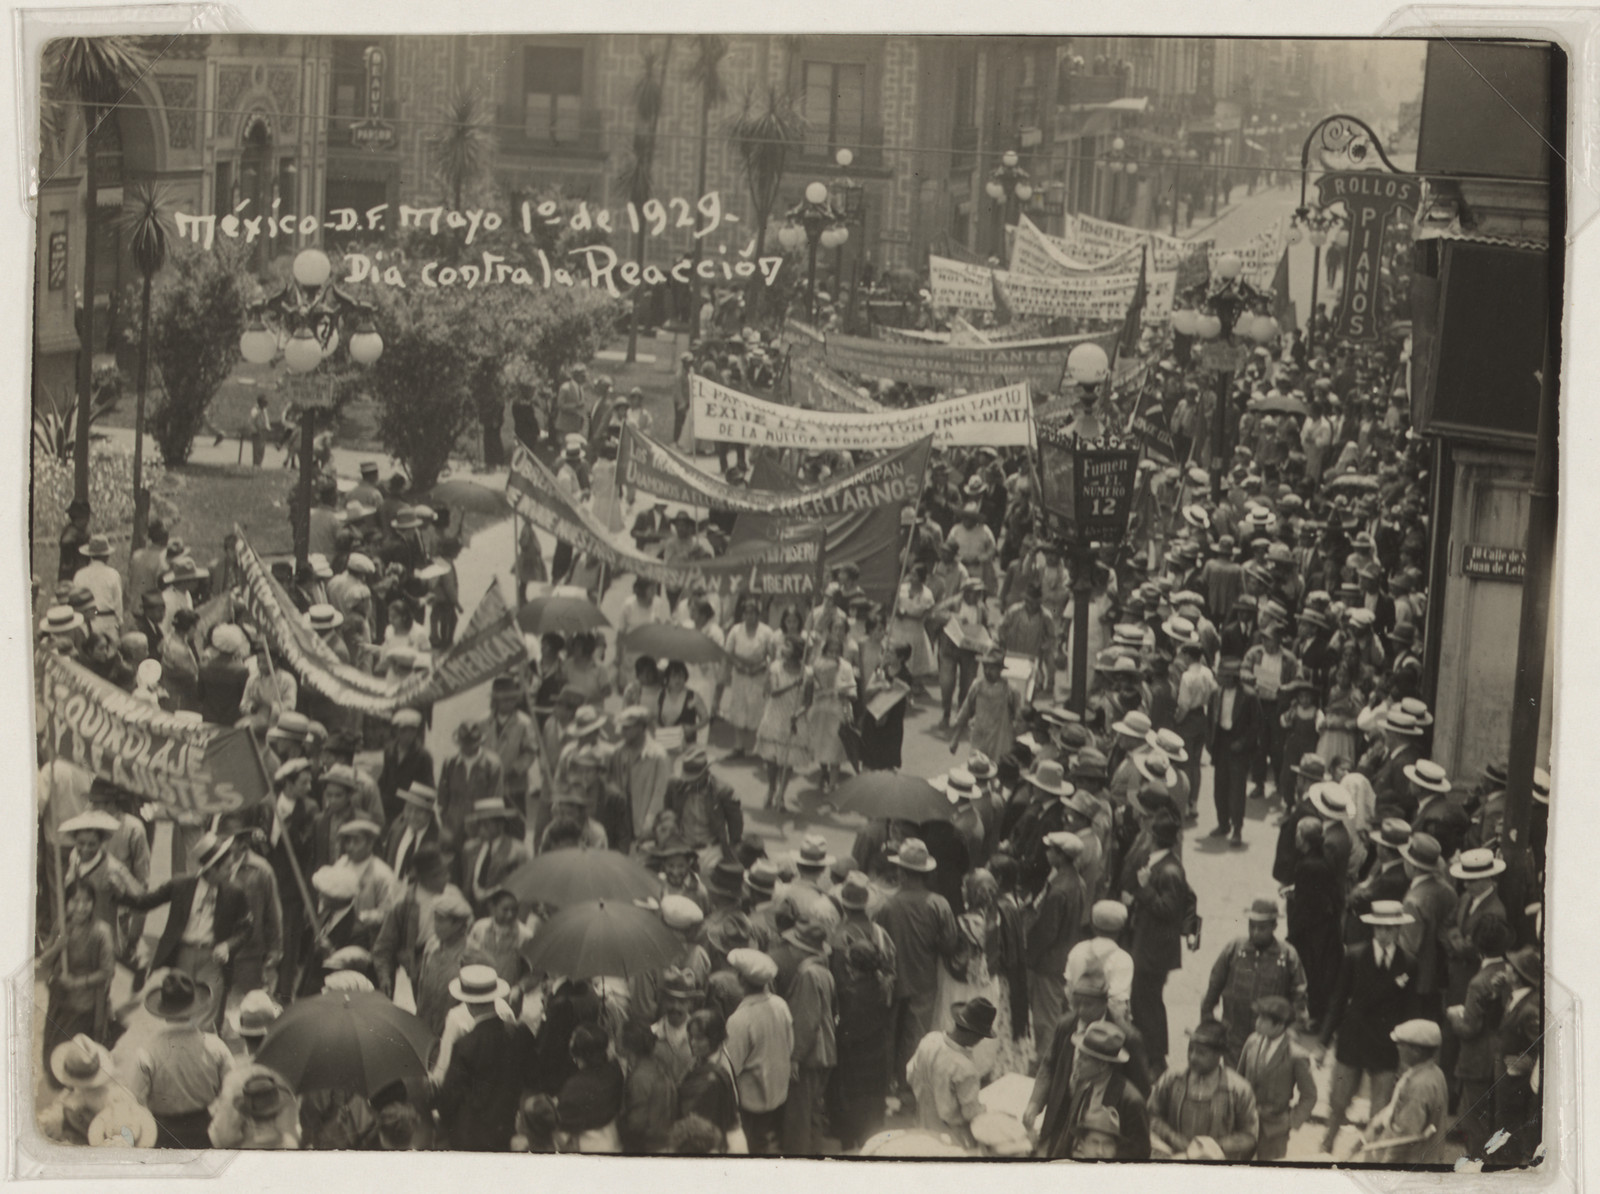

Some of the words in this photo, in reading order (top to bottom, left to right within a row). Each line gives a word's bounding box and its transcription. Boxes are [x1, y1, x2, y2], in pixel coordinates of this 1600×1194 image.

[1334, 177, 1412, 200] ROLLOS
[1350, 207, 1377, 335] PIANOS
[719, 422, 733, 436] DE
[1083, 459, 1128, 478] Fumen
[775, 474, 920, 516] IBERTARNOS
[1082, 486, 1126, 498] NUMERO
[1092, 498, 1117, 516] 12
[748, 564, 814, 594] LIBERTA
